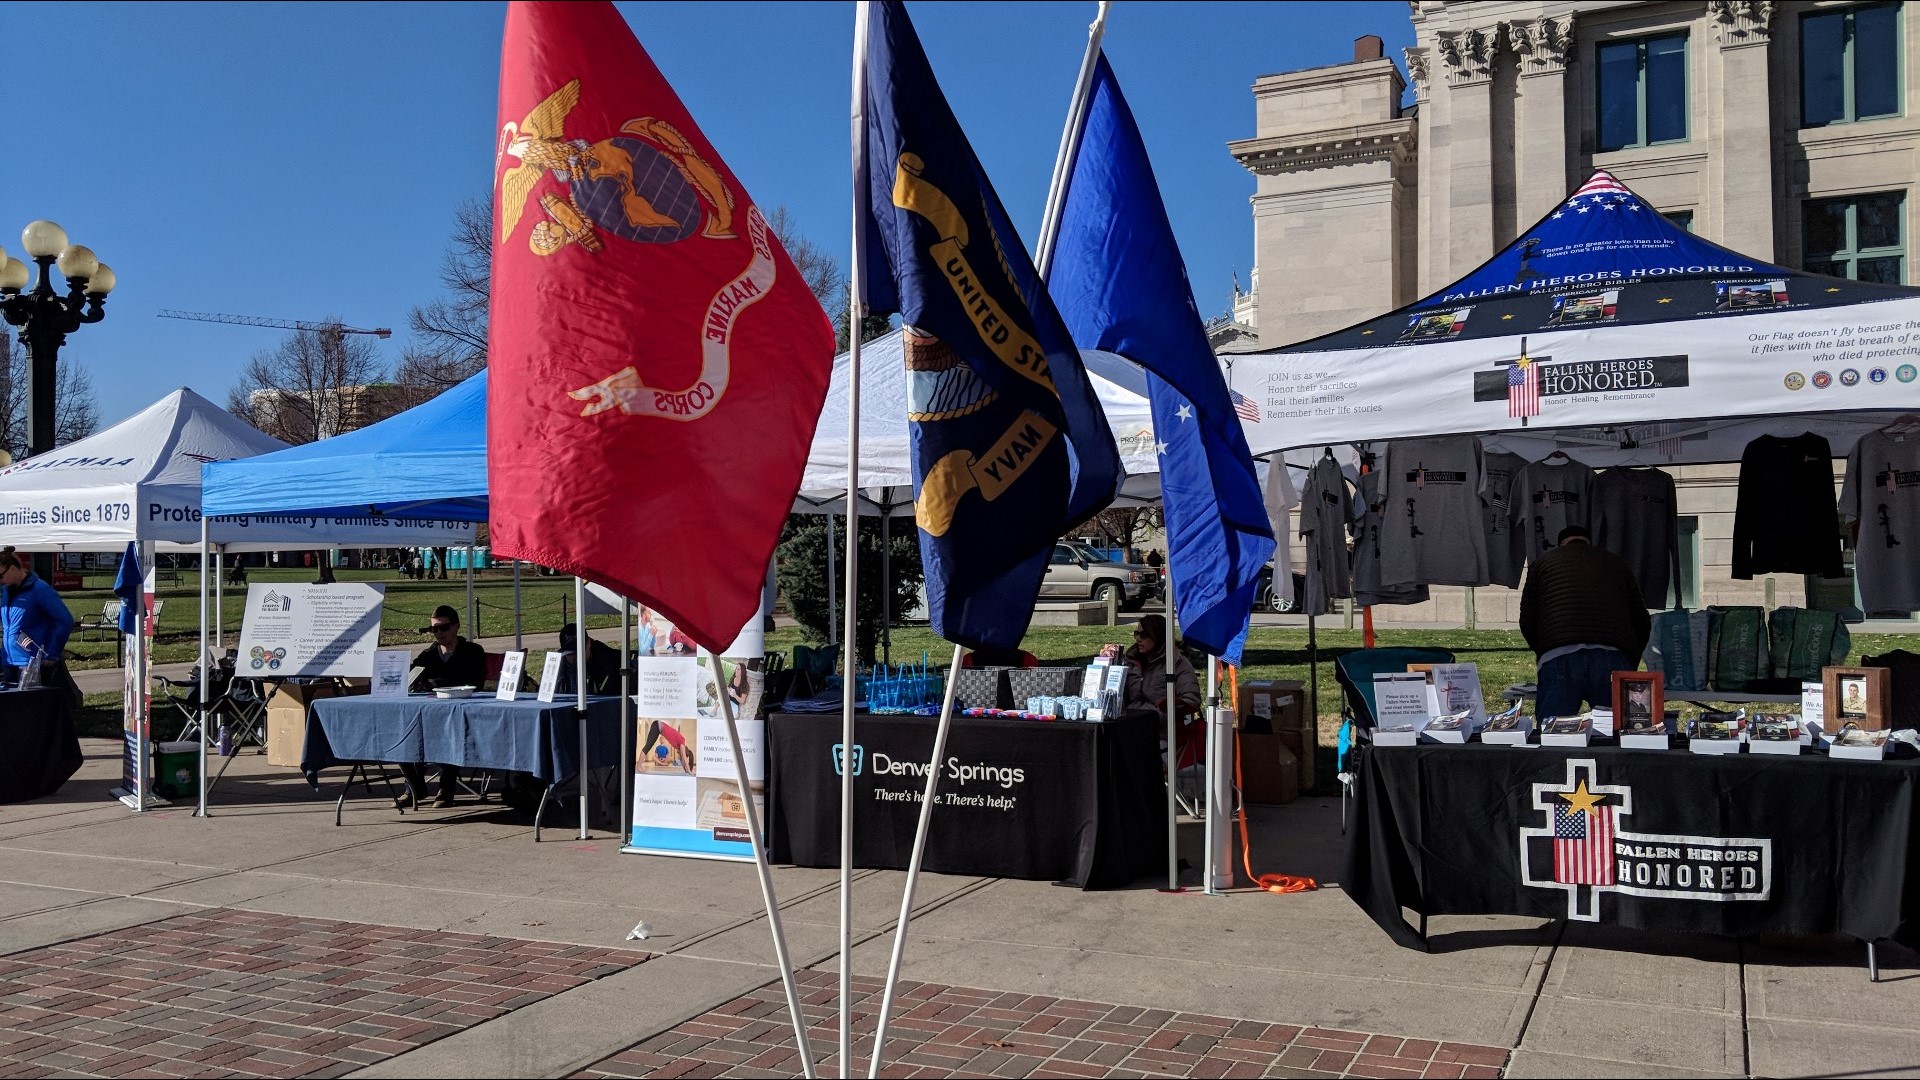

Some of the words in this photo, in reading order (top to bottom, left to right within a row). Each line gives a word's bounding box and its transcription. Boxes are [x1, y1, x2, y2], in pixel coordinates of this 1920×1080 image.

[1442, 282, 1523, 302] FALLEN
[1531, 270, 1622, 288] HEROES
[1630, 264, 1754, 277] HONORED
[1530, 286, 1568, 296] FALLEN
[1571, 282, 1602, 290] HERO
[946, 257, 1010, 346] UNITED
[1550, 288, 1598, 298] AMERICAN
[1748, 333, 1770, 342] Our
[1772, 332, 1794, 341] Flag
[1798, 327, 1837, 338] doesn't
[1839, 326, 1854, 336] fly
[1858, 322, 1902, 334] because
[1760, 344, 1784, 355] flies
[1788, 342, 1812, 352] with
[1816, 340, 1832, 349] the
[1836, 339, 1855, 348] last
[1859, 335, 1894, 346] breath
[1898, 333, 1911, 344] of
[1812, 354, 1836, 362] who
[1839, 351, 1863, 360] died
[1267, 372, 1289, 382] JOIN
[1544, 364, 1594, 378] FALLEN
[1600, 359, 1654, 372] HEROES
[1268, 385, 1294, 394] Honor
[1297, 384, 1316, 392] their
[1319, 380, 1358, 391] sacrifices
[1544, 370, 1655, 395] HONORED
[1267, 397, 1286, 407] Heal
[1290, 396, 1309, 406] their
[1311, 394, 1345, 404] families
[1544, 396, 1568, 406] Honor
[1571, 394, 1600, 404] Healing
[1603, 392, 1656, 402] Remembrance
[1267, 409, 1312, 419] Remember
[1314, 407, 1335, 416] their
[1337, 406, 1350, 414] life
[1354, 403, 1382, 413] stories
[51, 504, 90, 523] Since
[96, 502, 130, 522] 1879
[948, 756, 1025, 788] Springs
[874, 788, 912, 802] There's
[914, 790, 943, 804] hoe.
[946, 792, 984, 807] There's
[1615, 842, 1680, 860] FALLEN
[1686, 846, 1759, 862] HEROES
[1618, 860, 1757, 890] HONORED
